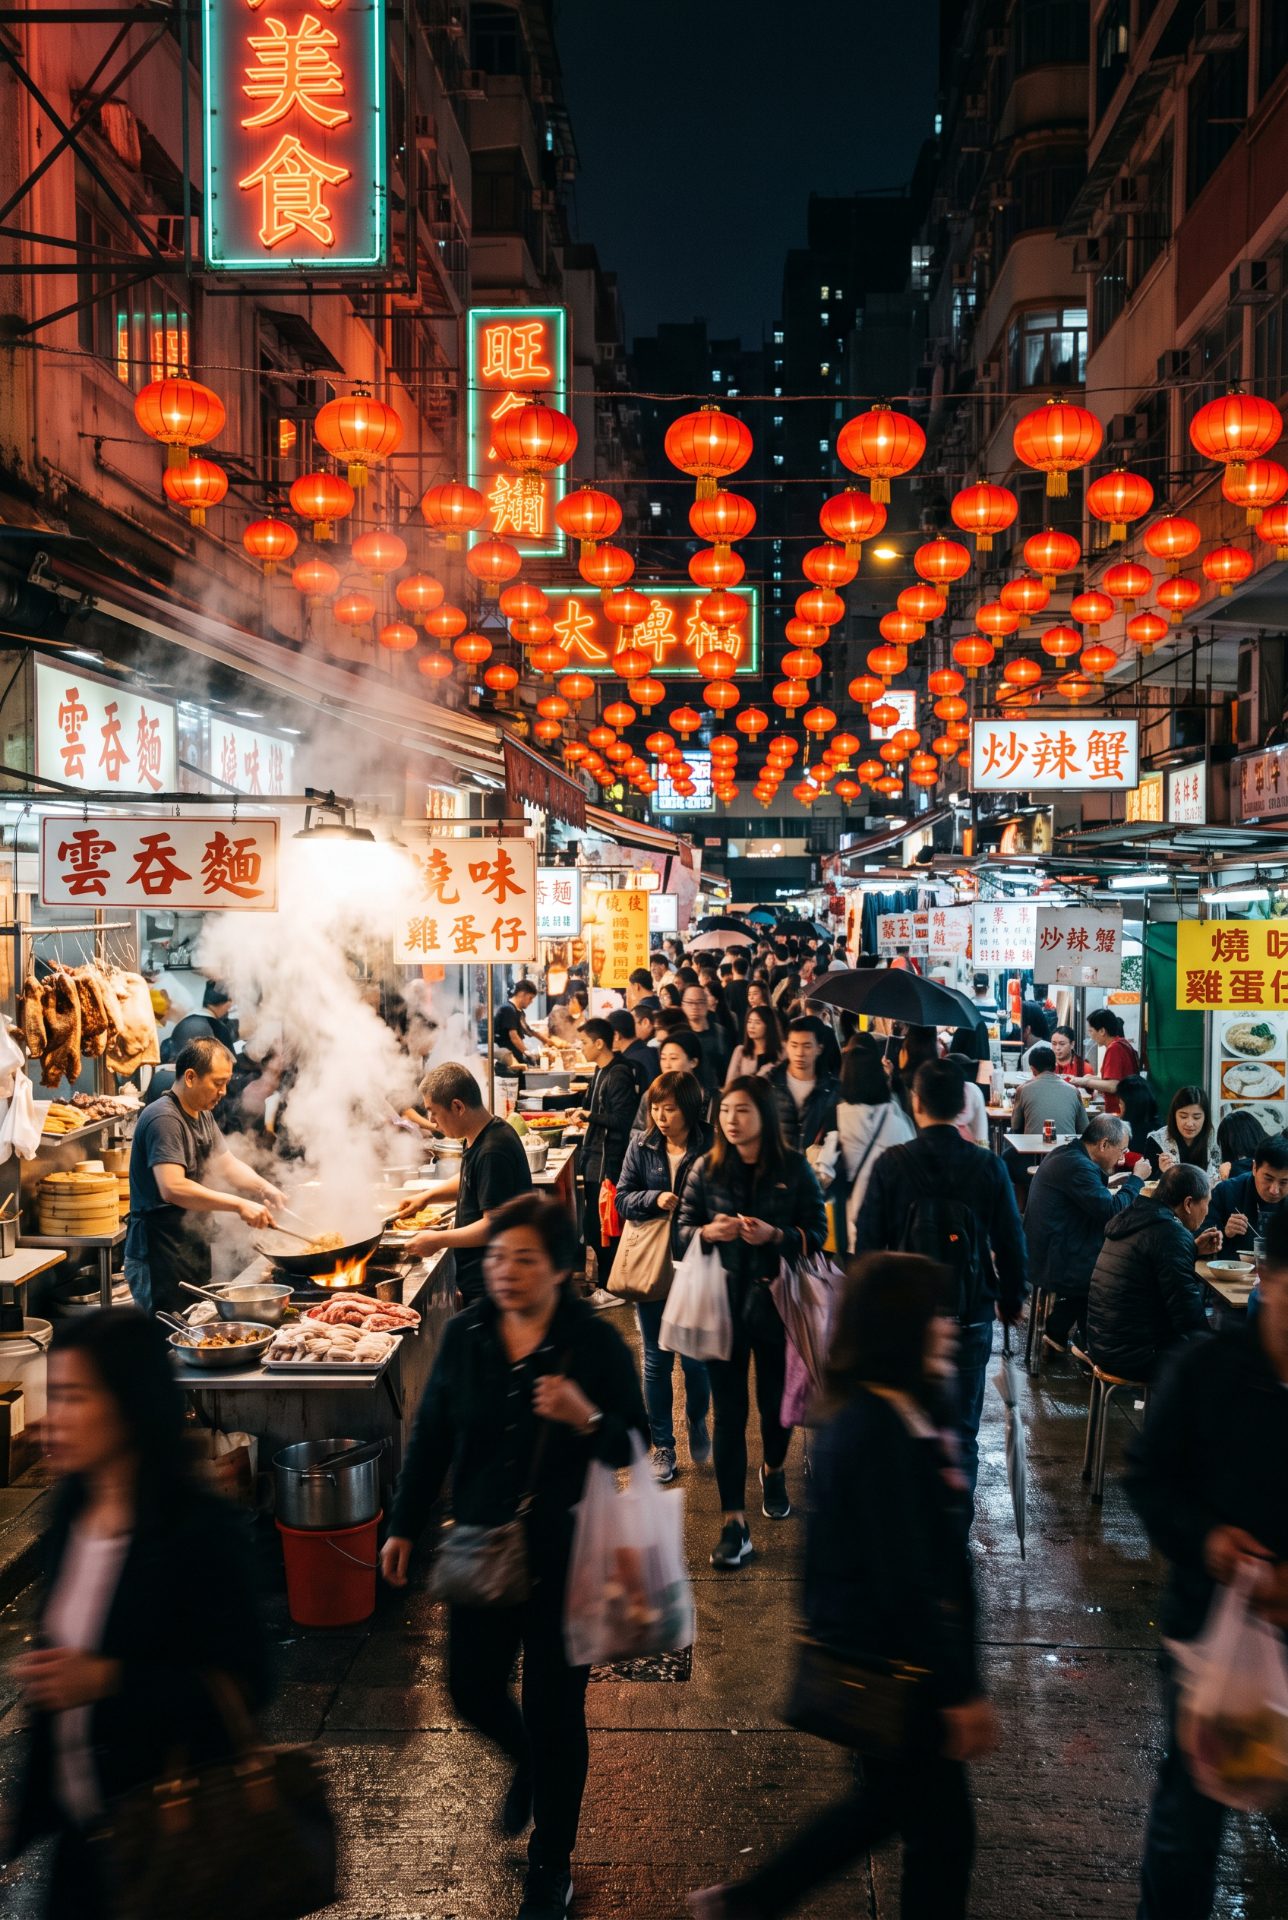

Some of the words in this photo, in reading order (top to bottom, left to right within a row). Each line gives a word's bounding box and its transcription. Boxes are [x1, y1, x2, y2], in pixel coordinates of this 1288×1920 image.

[239, 0, 351, 248] 美食
[58, 687, 163, 792] 雲吞麵
[981, 729, 1129, 781] 炒辣蟹
[57, 829, 264, 898] 雲吞麵
[404, 914, 527, 954] 雞蛋仔
